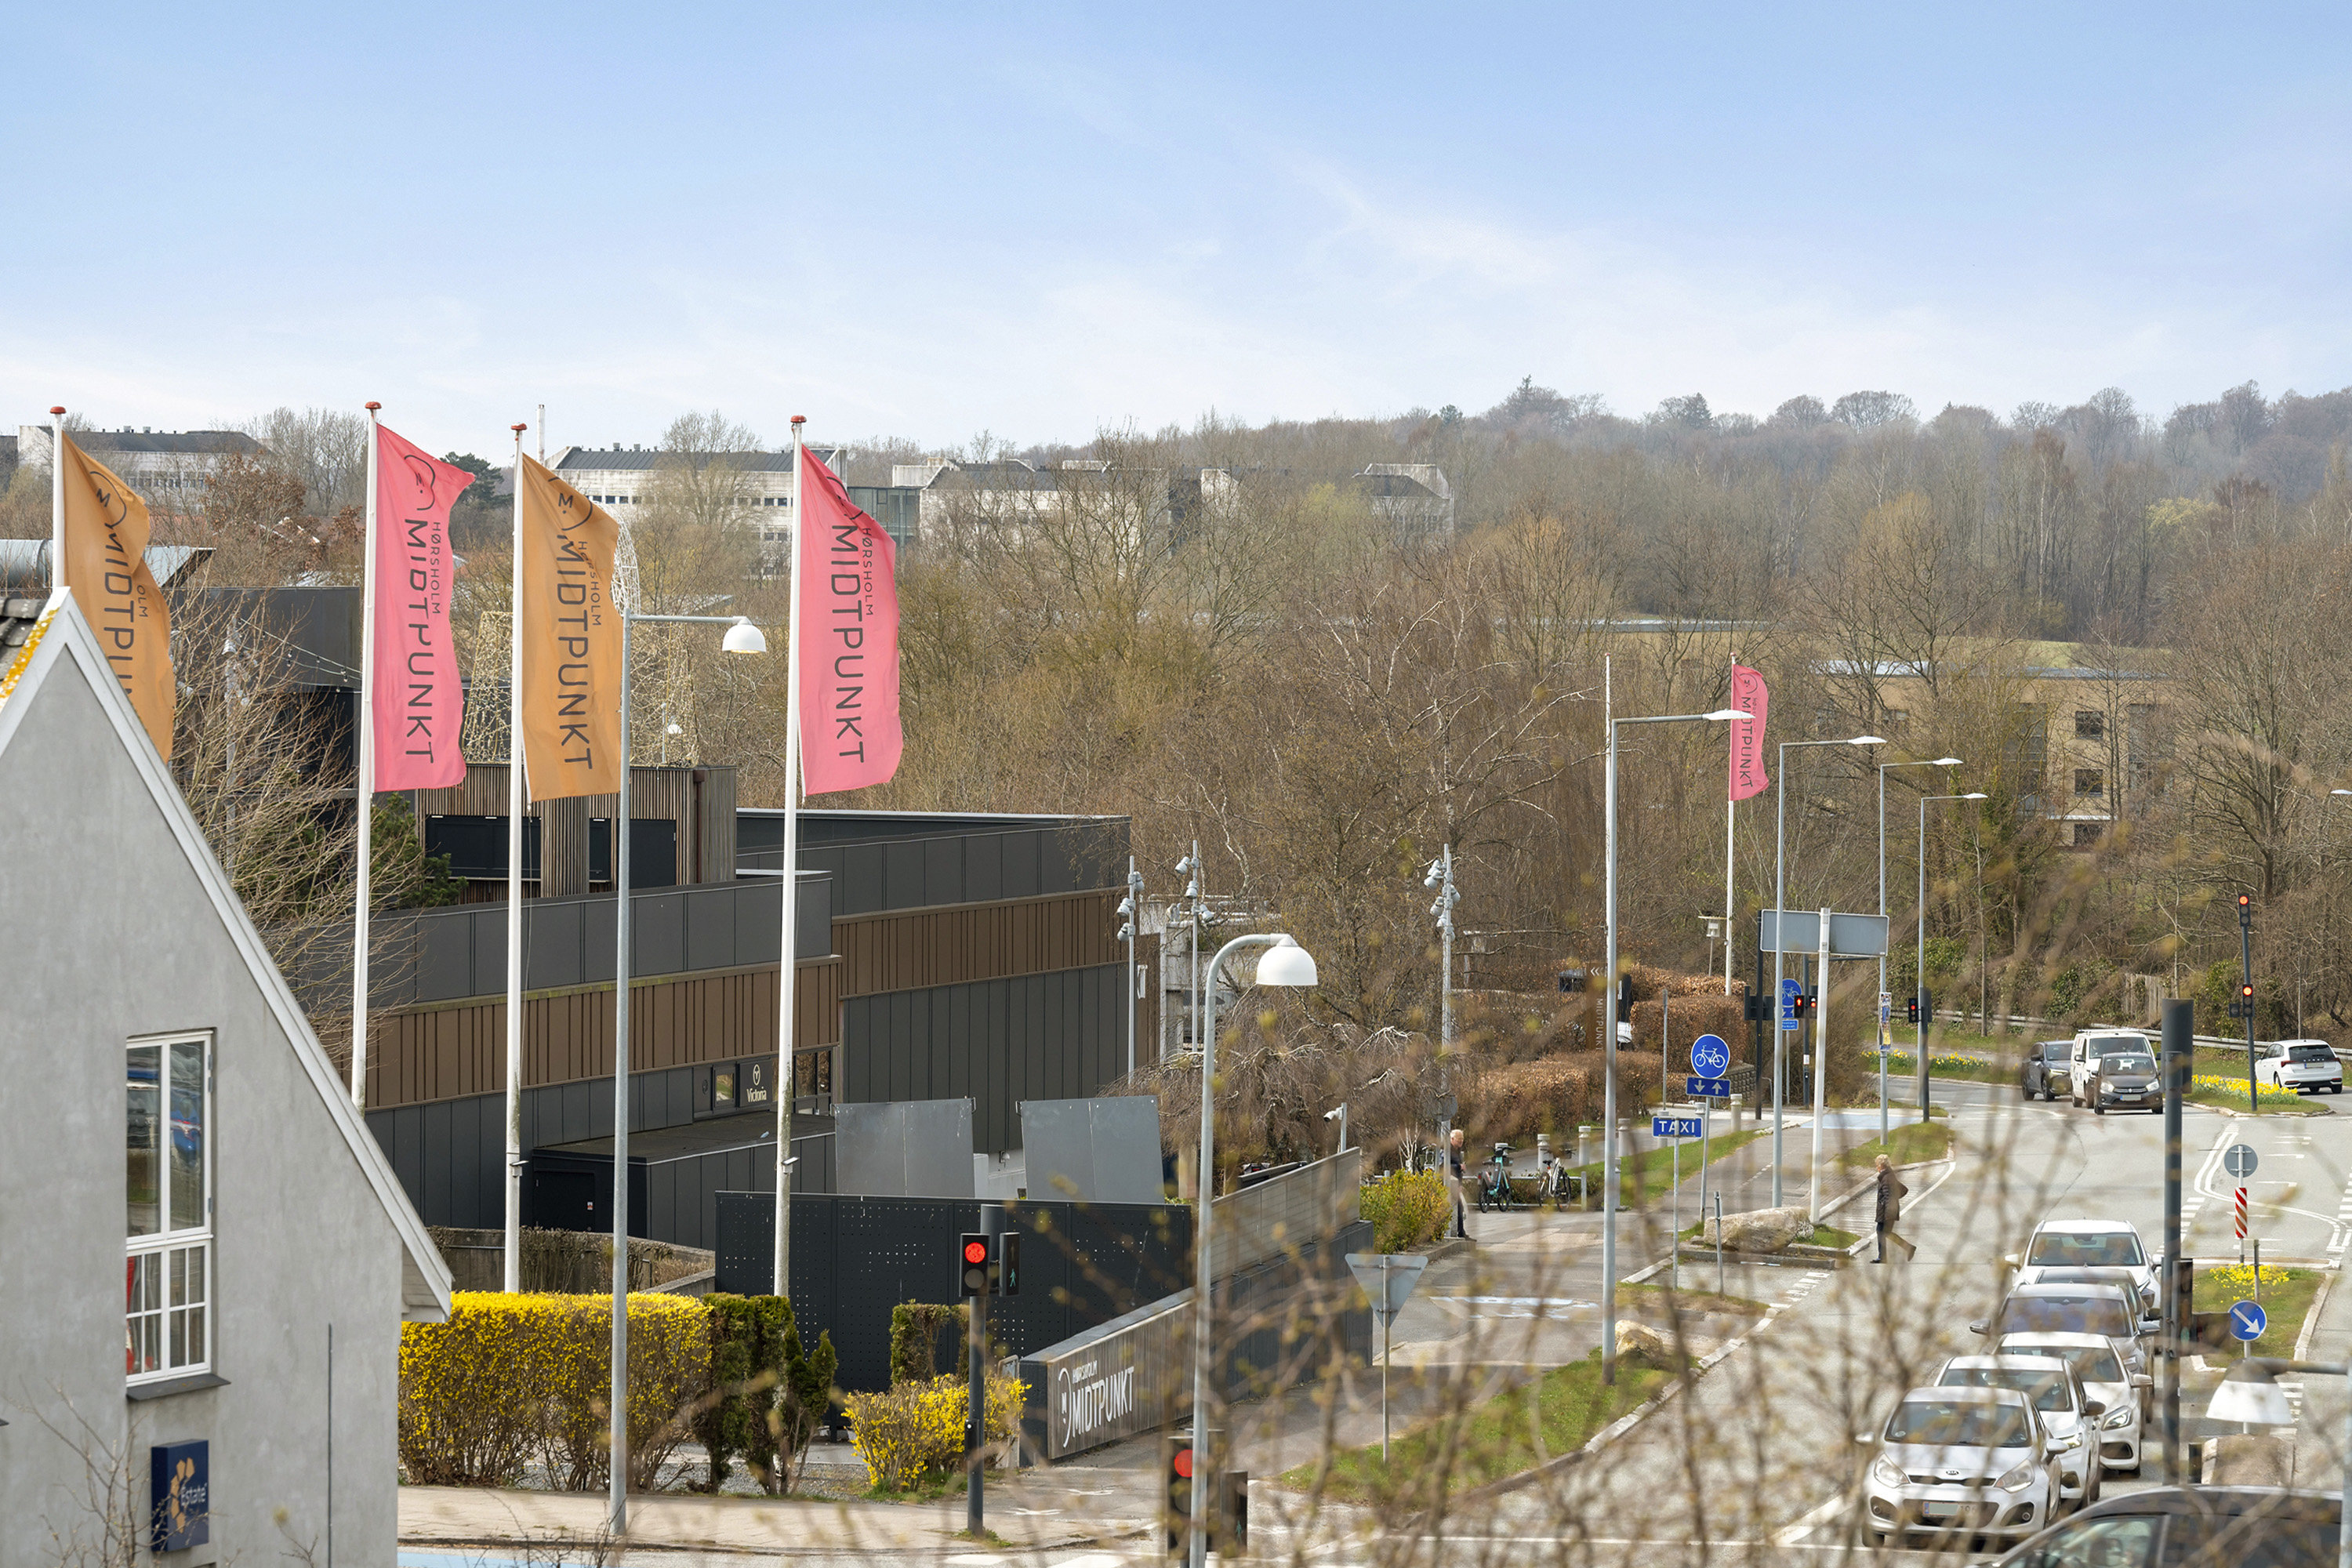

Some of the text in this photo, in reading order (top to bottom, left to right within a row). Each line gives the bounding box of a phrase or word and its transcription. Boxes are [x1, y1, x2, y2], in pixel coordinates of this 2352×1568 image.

[430, 521, 441, 615] HØRSHOLM
[862, 527, 873, 616] HØRSHOLM
[405, 518, 434, 764] MIDTPUNKT
[556, 534, 593, 770] MIDTPUNKT
[831, 524, 865, 763] MIDTPUNKT
[1595, 998, 1604, 1051] MIDTPUNKT
[746, 1086, 768, 1102] Victoria
[1658, 1120, 1695, 1133] TAXI
[1073, 1366, 1134, 1438] MIDTPUNKT
